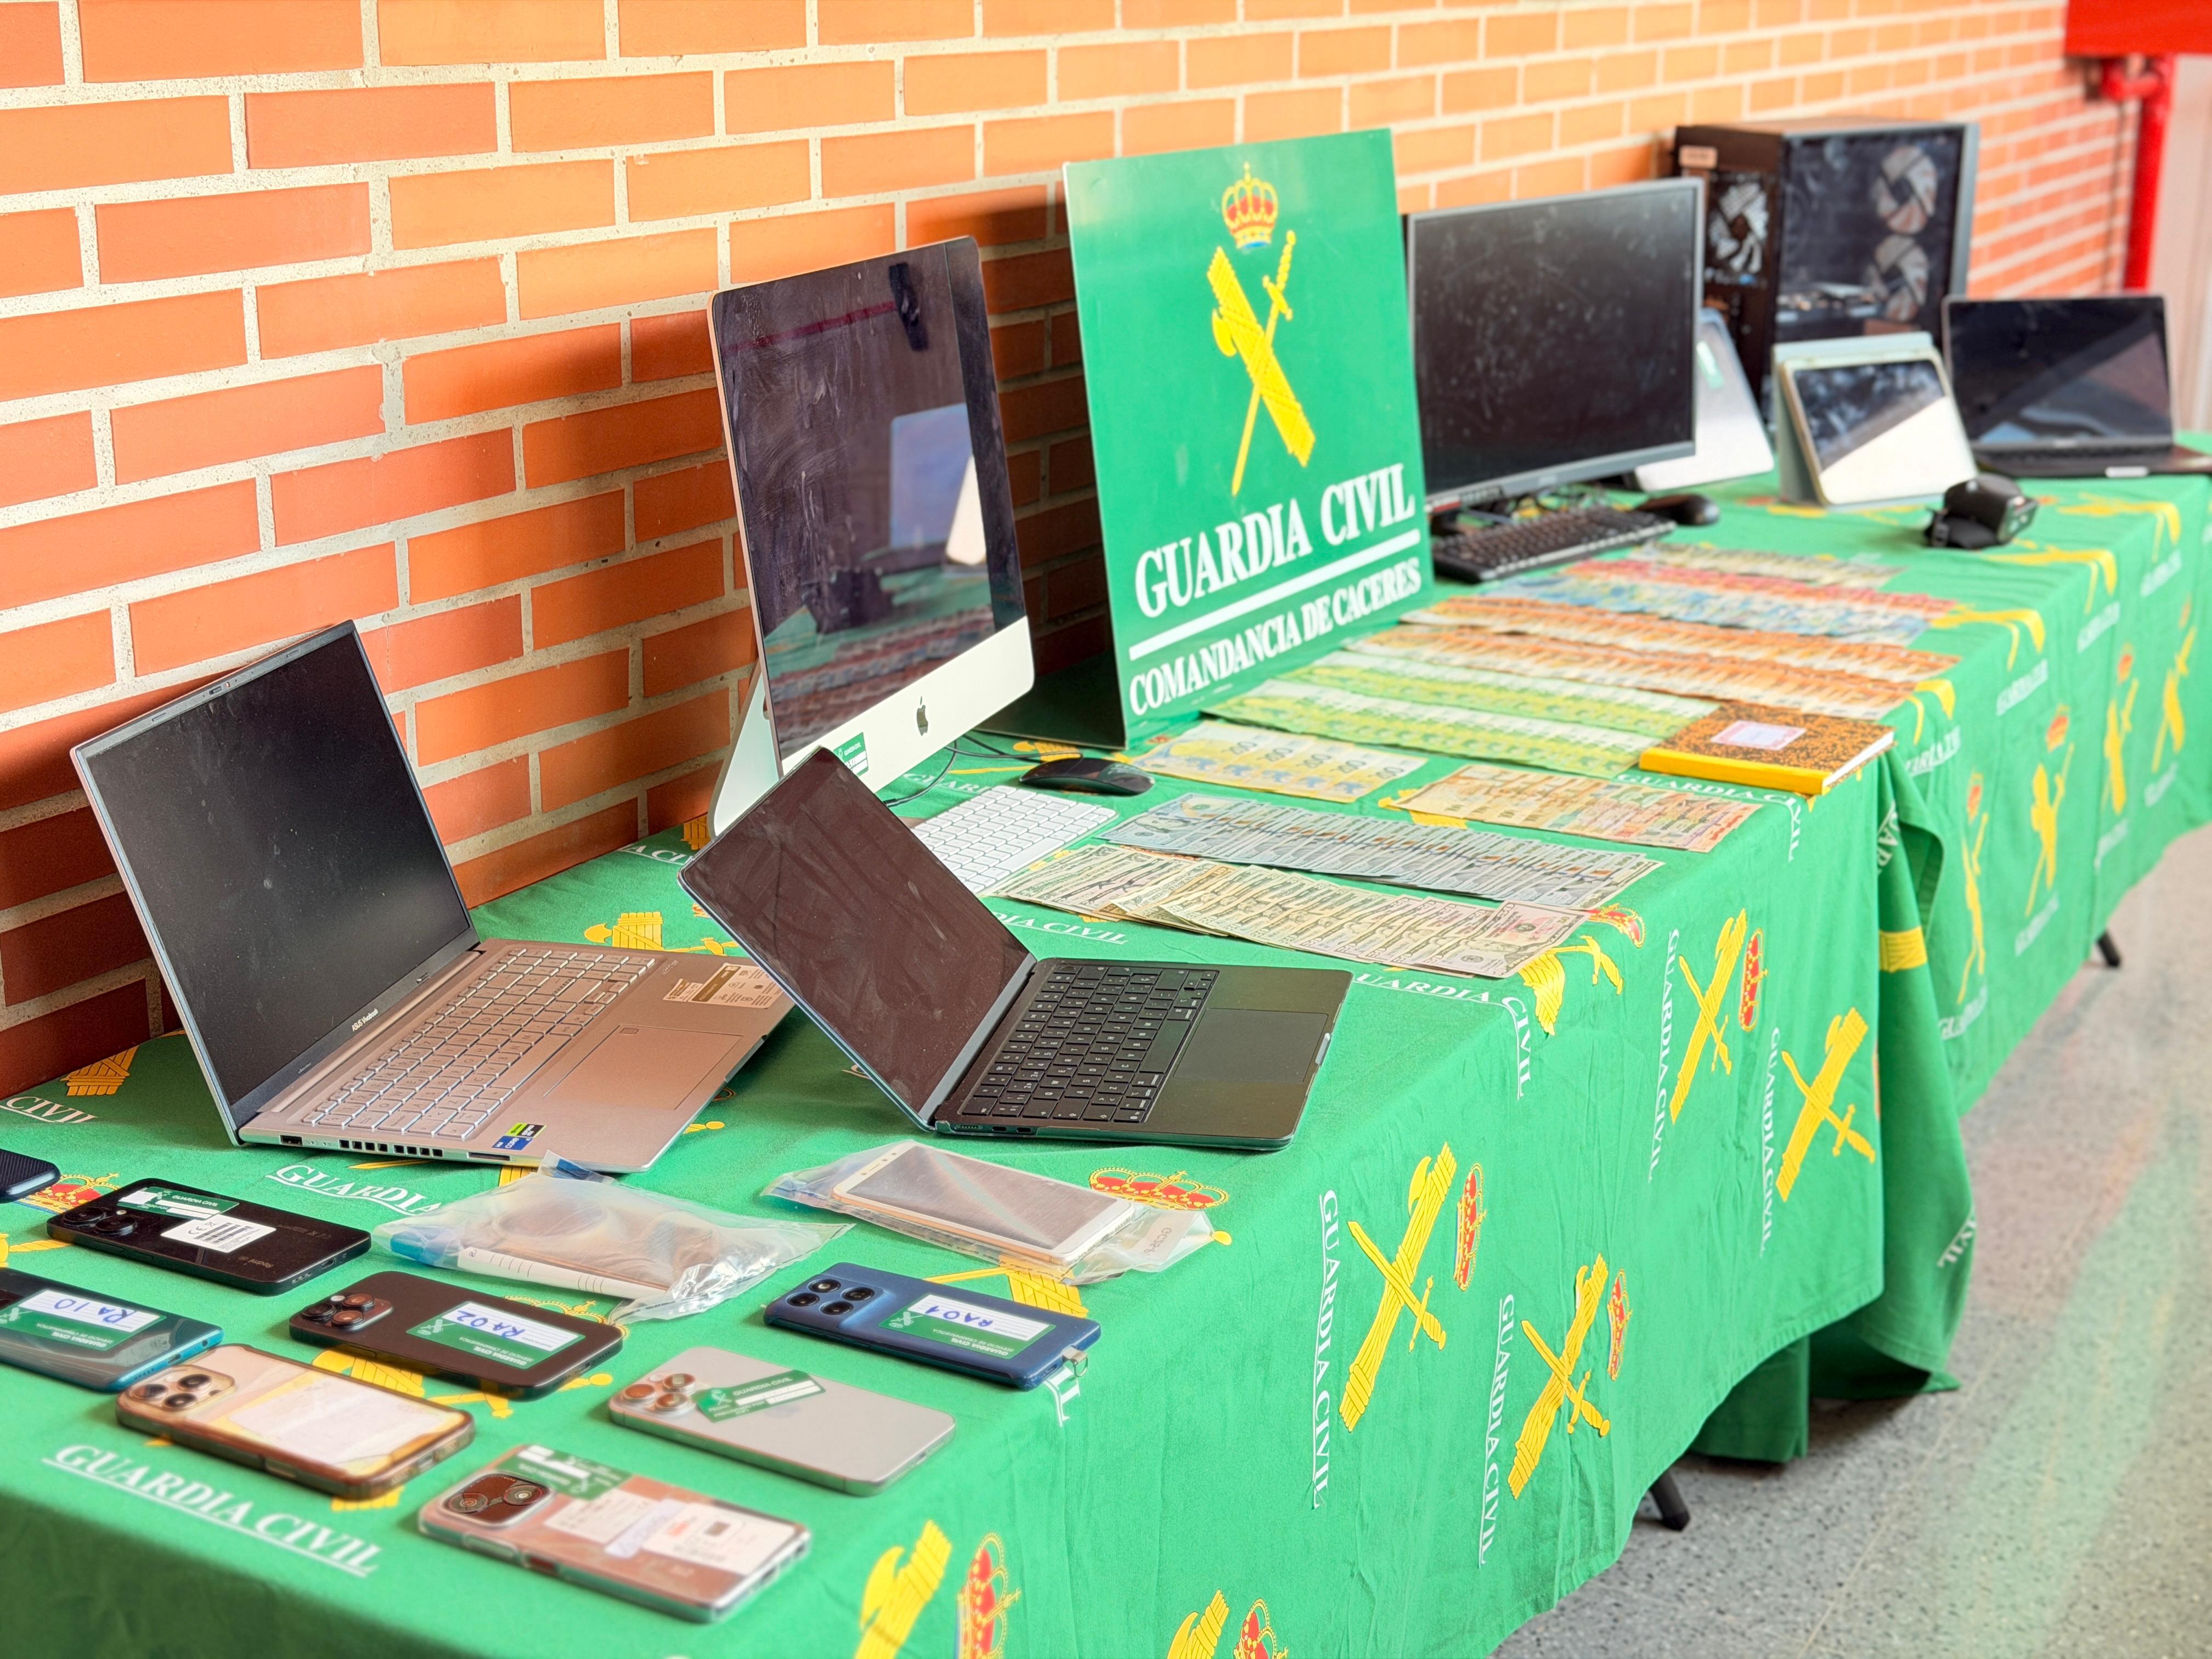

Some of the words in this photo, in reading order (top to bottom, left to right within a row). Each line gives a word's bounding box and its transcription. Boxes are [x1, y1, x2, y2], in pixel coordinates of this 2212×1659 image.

[1135, 498, 1313, 618] GUARDIA
[1320, 462, 1415, 546] CIVIL
[1129, 611, 1302, 715] COMANDANCIA
[1302, 595, 1333, 641] DE
[1332, 557, 1422, 626] CACERES
[1617, 774, 1757, 799] GUARDIA
[1764, 794, 1802, 861] CIVIL
[1043, 922, 1128, 943] CIVIL
[351, 1019, 363, 1032] ASUS
[362, 1008, 379, 1025] Vivobook
[1357, 973, 1489, 1002] UARDIA
[1502, 997, 1531, 1097] CIVIL
[1657, 929, 1679, 1088] GUARDIA
[1763, 1027, 1781, 1166] GUARDIA
[1649, 1088, 1667, 1183] CIVIL
[172, 1194, 202, 1204] GUARDIA
[1761, 1168, 1774, 1254] CIVIL
[248, 1259, 274, 1268] Redmi
[1317, 1190, 1340, 1384] GUARDIA
[52, 1331, 72, 1340] CIVIL
[72, 1336, 107, 1348] GUARDIA
[473, 1346, 494, 1357] CIVIL
[494, 1353, 527, 1365] GUARDIA
[508, 1351, 534, 1362] SERVICIO
[950, 1337, 974, 1347] CIVIL
[972, 1344, 1009, 1357] GUARDIA
[988, 1342, 1014, 1353] SERVICIO
[733, 1383, 771, 1396] GUARDIA
[771, 1377, 793, 1386] CIVIL
[1487, 1294, 1514, 1462] GUARDIA
[1314, 1390, 1331, 1508] CIVIL
[56, 1444, 254, 1527] GUARDIA
[256, 1511, 382, 1573] CIVIL
[1481, 1462, 1499, 1566] CIVIL
